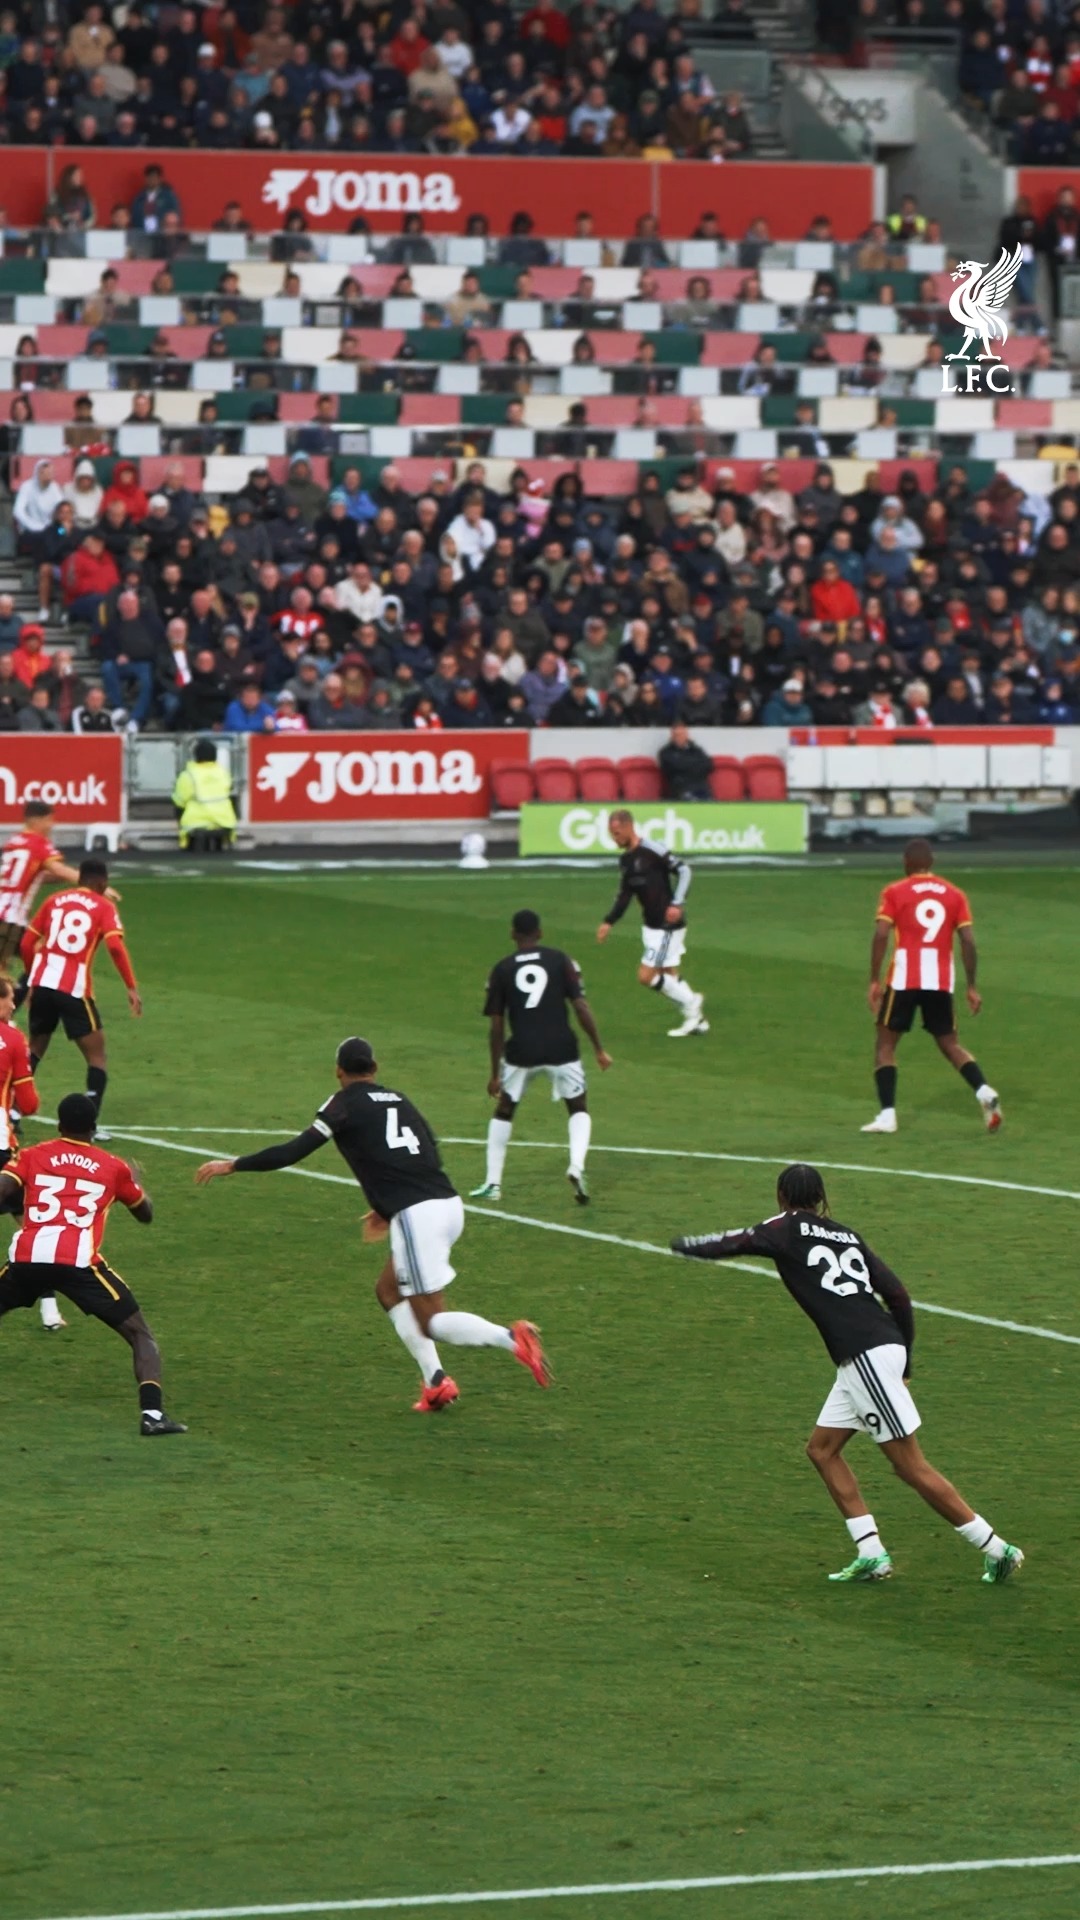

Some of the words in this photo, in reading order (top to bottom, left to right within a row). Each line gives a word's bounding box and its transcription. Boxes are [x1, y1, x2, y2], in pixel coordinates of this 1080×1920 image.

[560, 808, 765, 850] Gtch.co.uk
[47, 907, 92, 954] 18
[915, 898, 946, 943] 9
[515, 964, 549, 1009] 9
[385, 1107, 421, 1155] 4
[49, 1152, 101, 1174] KAYODE
[28, 1174, 106, 1229] 33
[807, 1245, 874, 1297] 29
